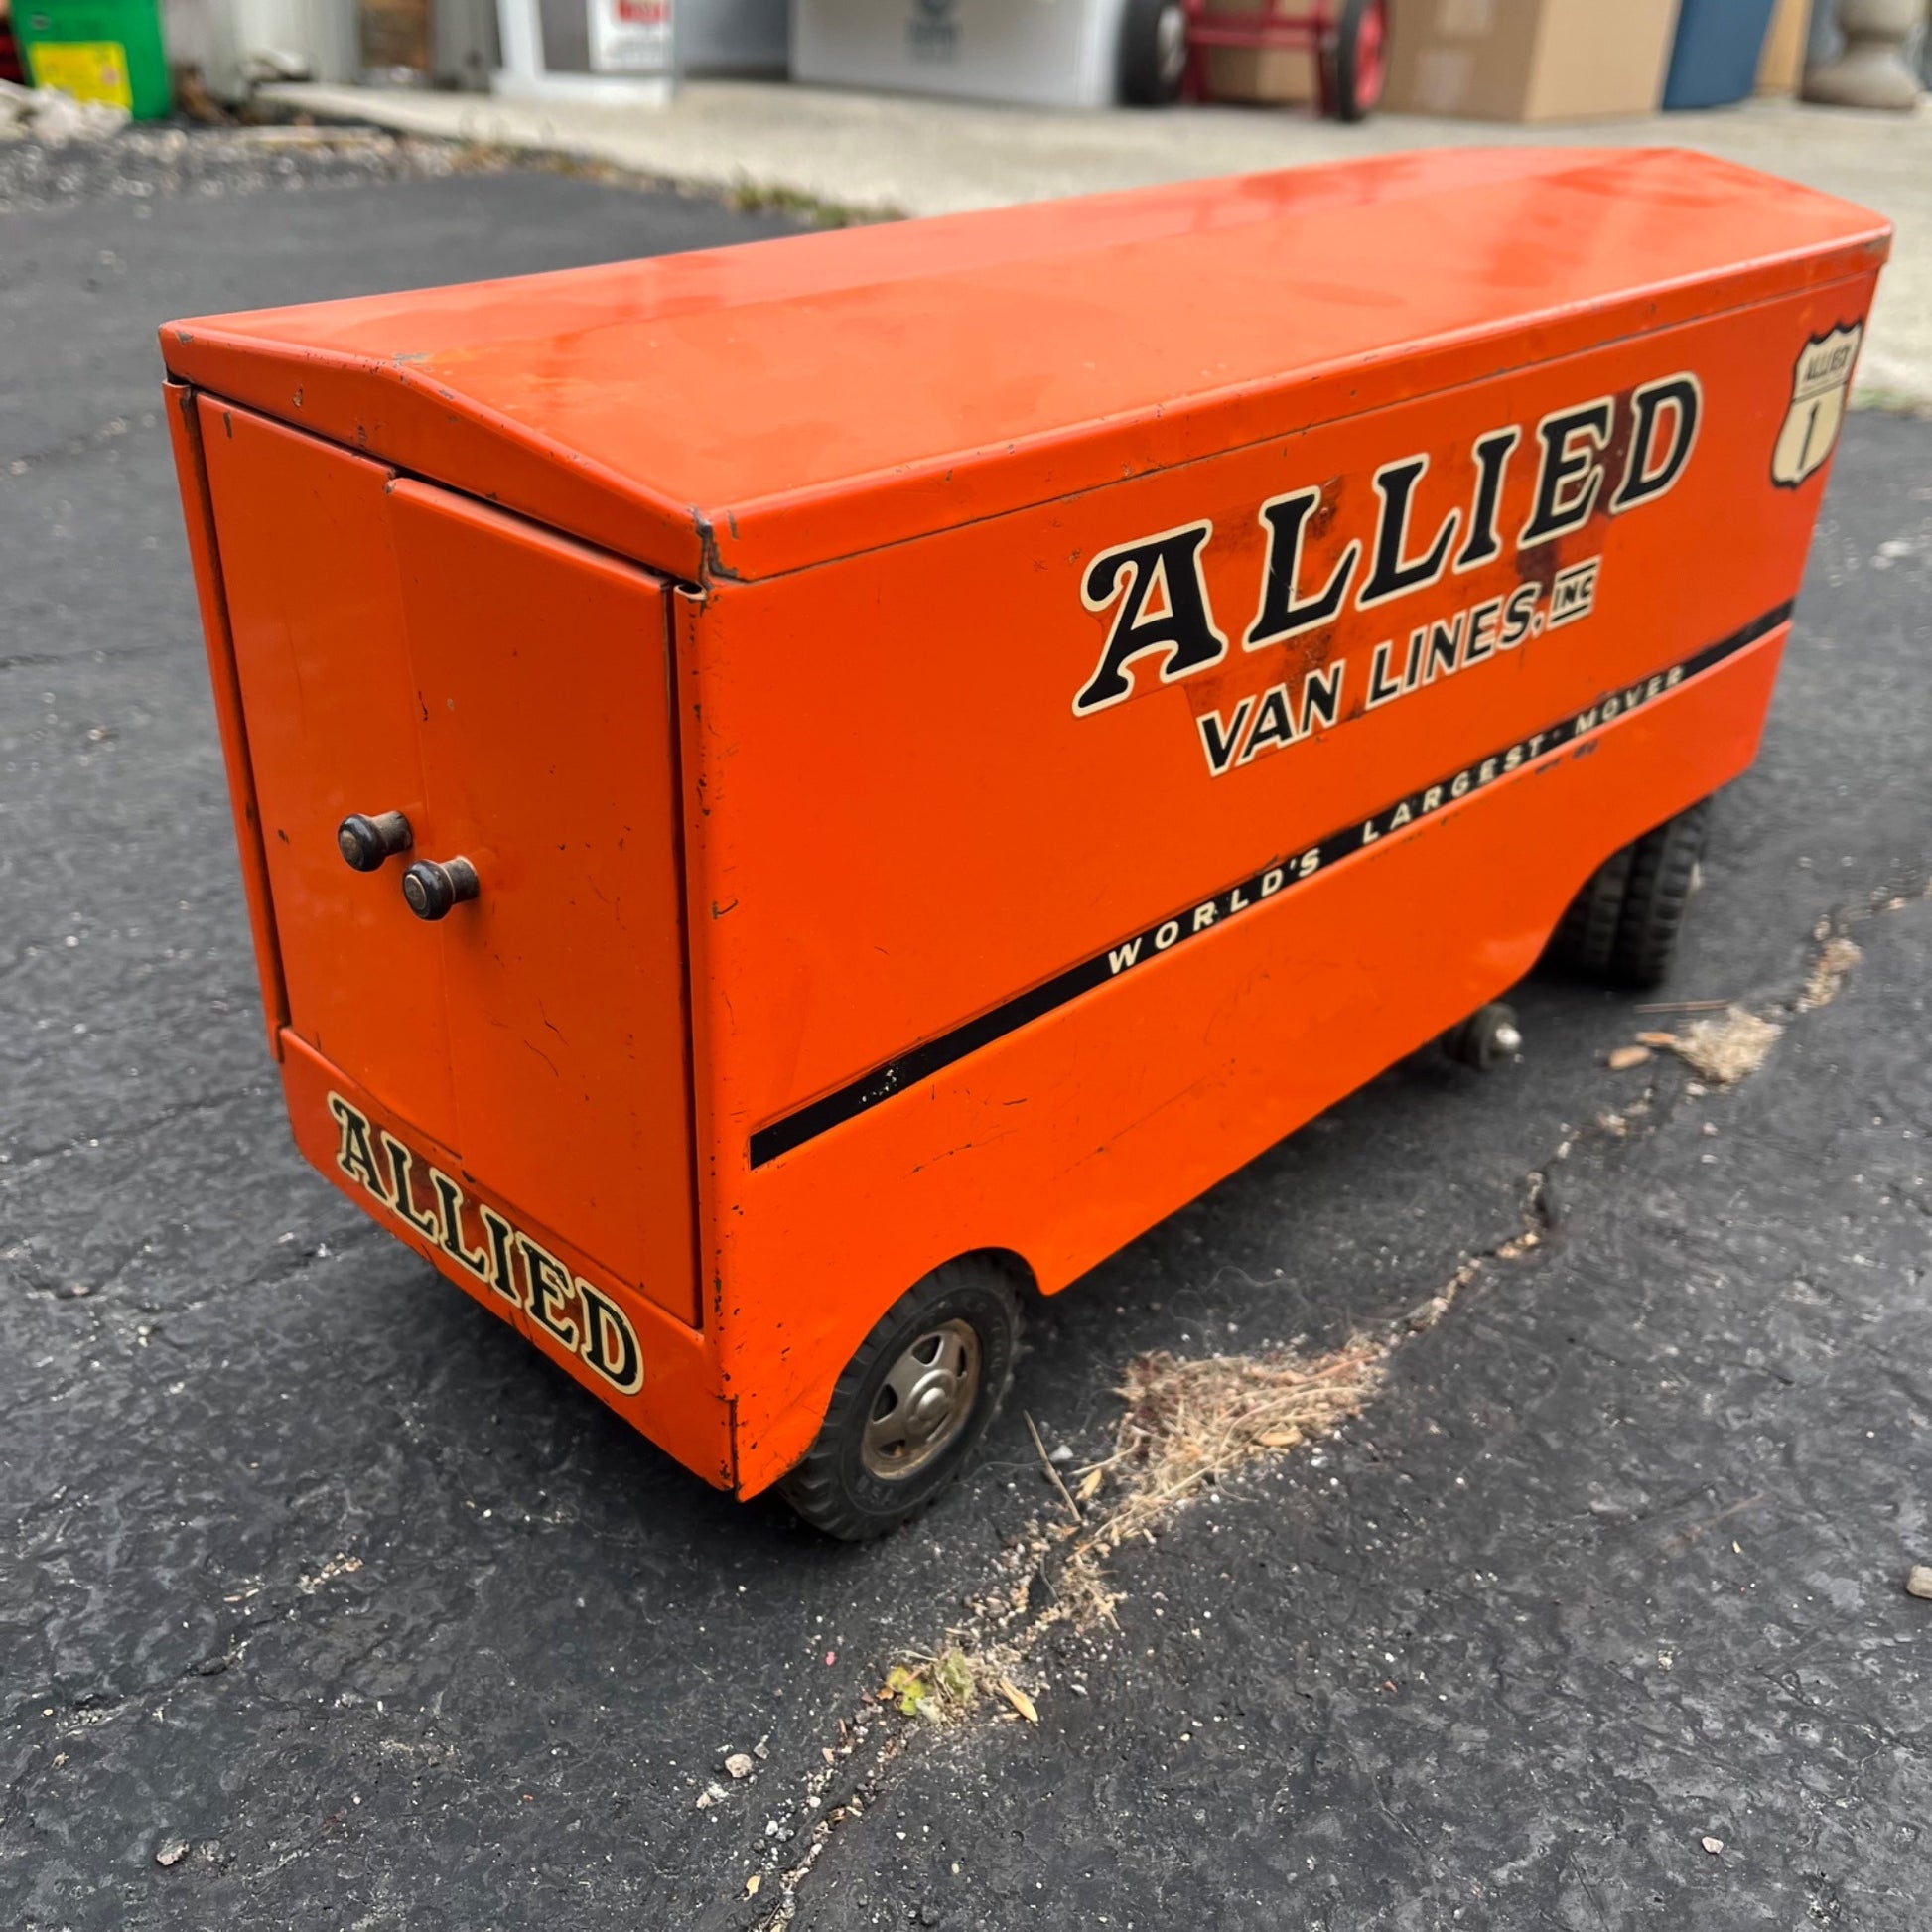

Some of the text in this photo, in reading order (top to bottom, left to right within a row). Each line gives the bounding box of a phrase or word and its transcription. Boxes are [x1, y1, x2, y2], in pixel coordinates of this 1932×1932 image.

[1072, 371, 1704, 716] ALLIED
[1108, 664, 1684, 975] WORLD'S LARGEST MOVER
[1196, 659, 1345, 777] VAN
[327, 1090, 644, 1398] ALLIED
